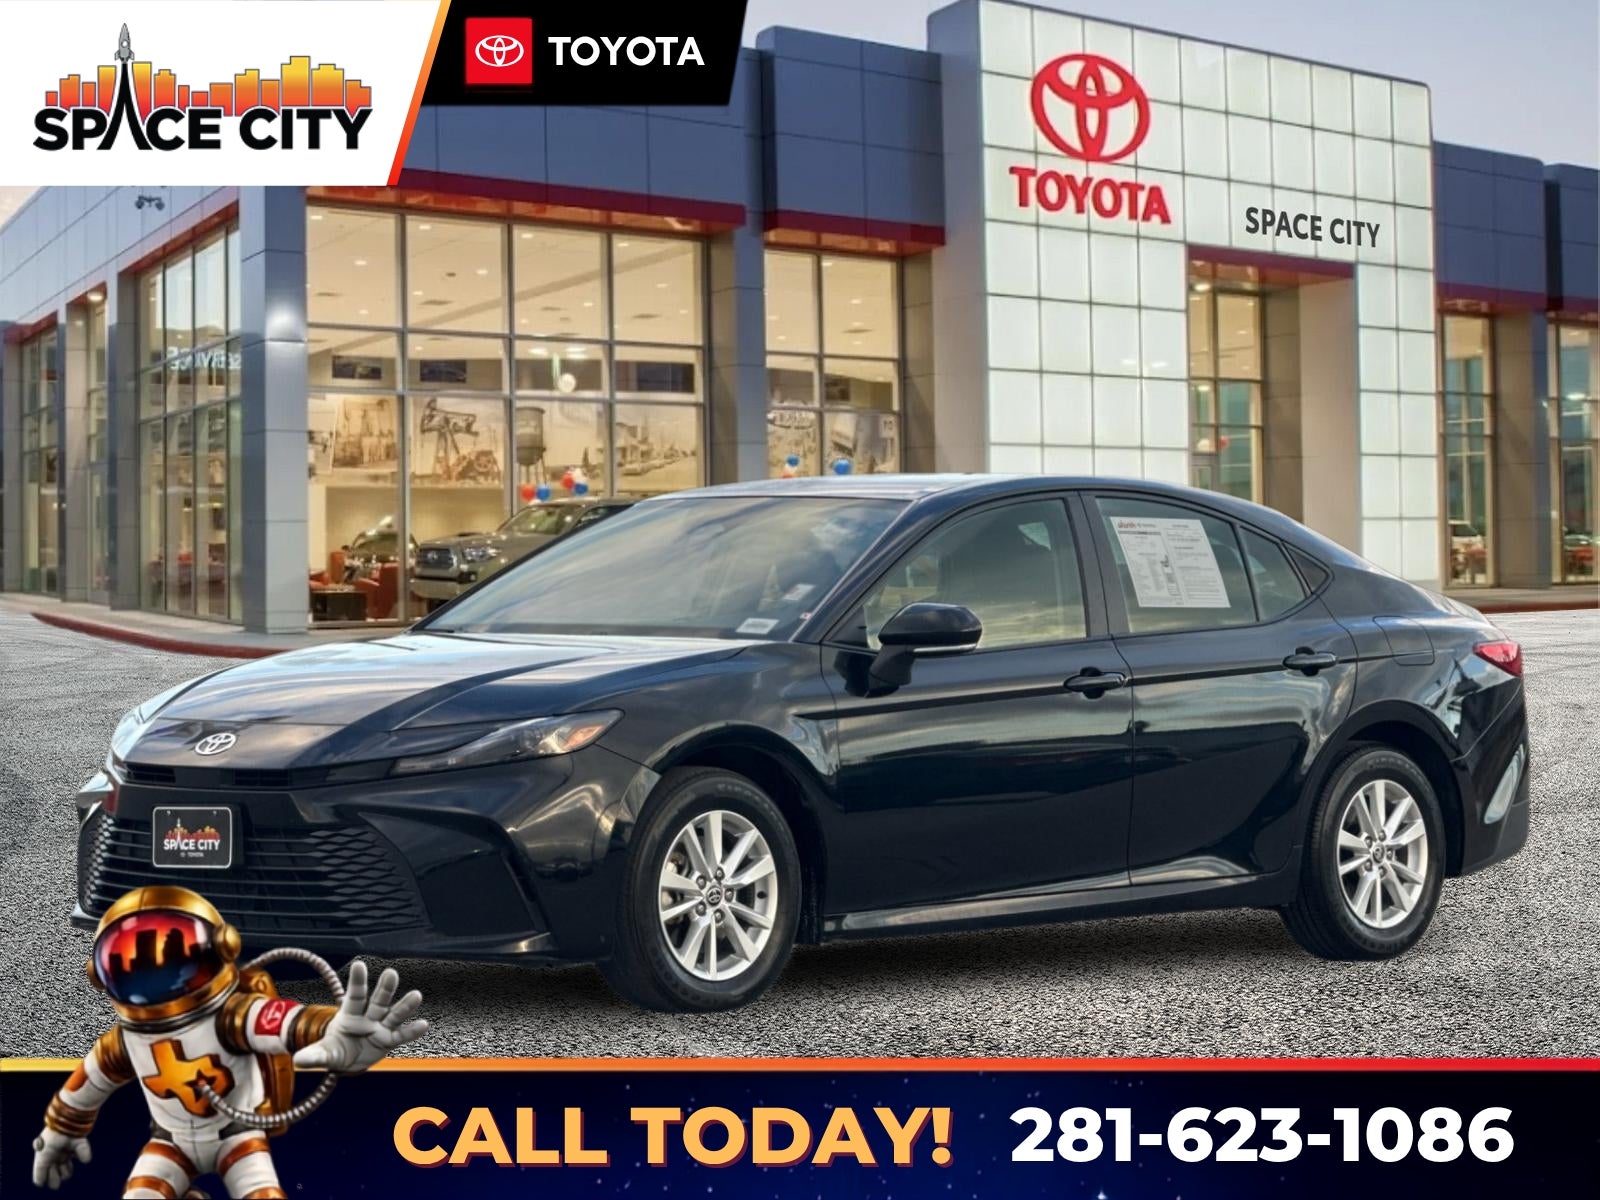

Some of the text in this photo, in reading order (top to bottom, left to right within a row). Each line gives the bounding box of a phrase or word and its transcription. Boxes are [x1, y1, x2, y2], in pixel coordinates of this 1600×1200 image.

[1009, 166, 1171, 224] TOYOTA
[1245, 206, 1381, 249] SPACE CITY
[163, 838, 220, 850] SPACE CITY
